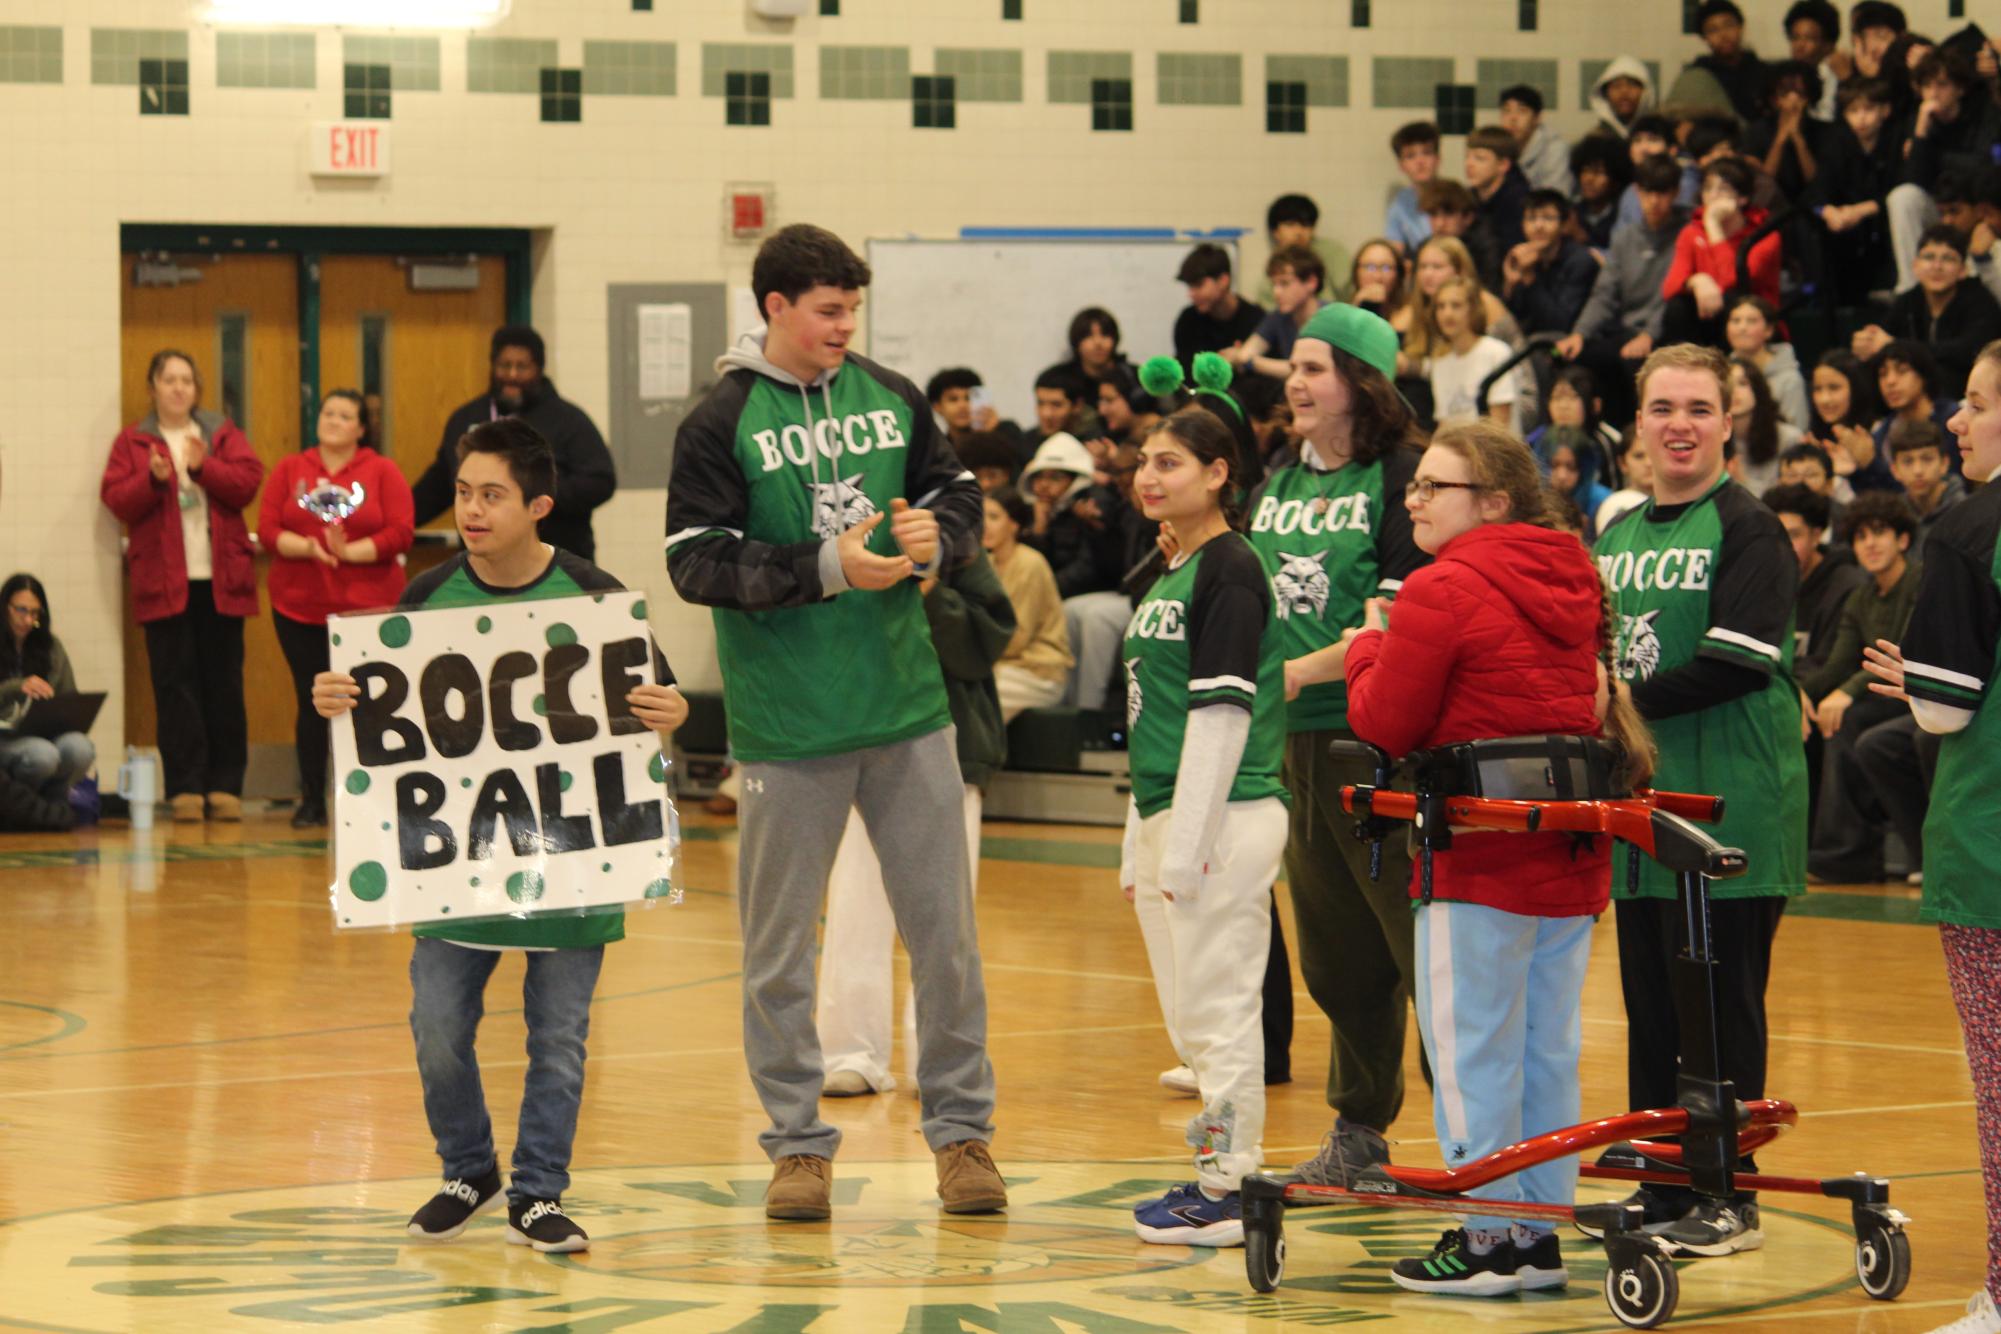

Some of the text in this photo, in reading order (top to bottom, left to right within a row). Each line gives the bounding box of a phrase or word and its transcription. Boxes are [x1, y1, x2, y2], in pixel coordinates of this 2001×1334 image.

[330, 127, 378, 168] EXIT
[752, 409, 905, 472] BOCCE
[1250, 492, 1370, 535] BOCCE
[350, 636, 654, 767] BOCCE
[396, 751, 664, 870] BALL
